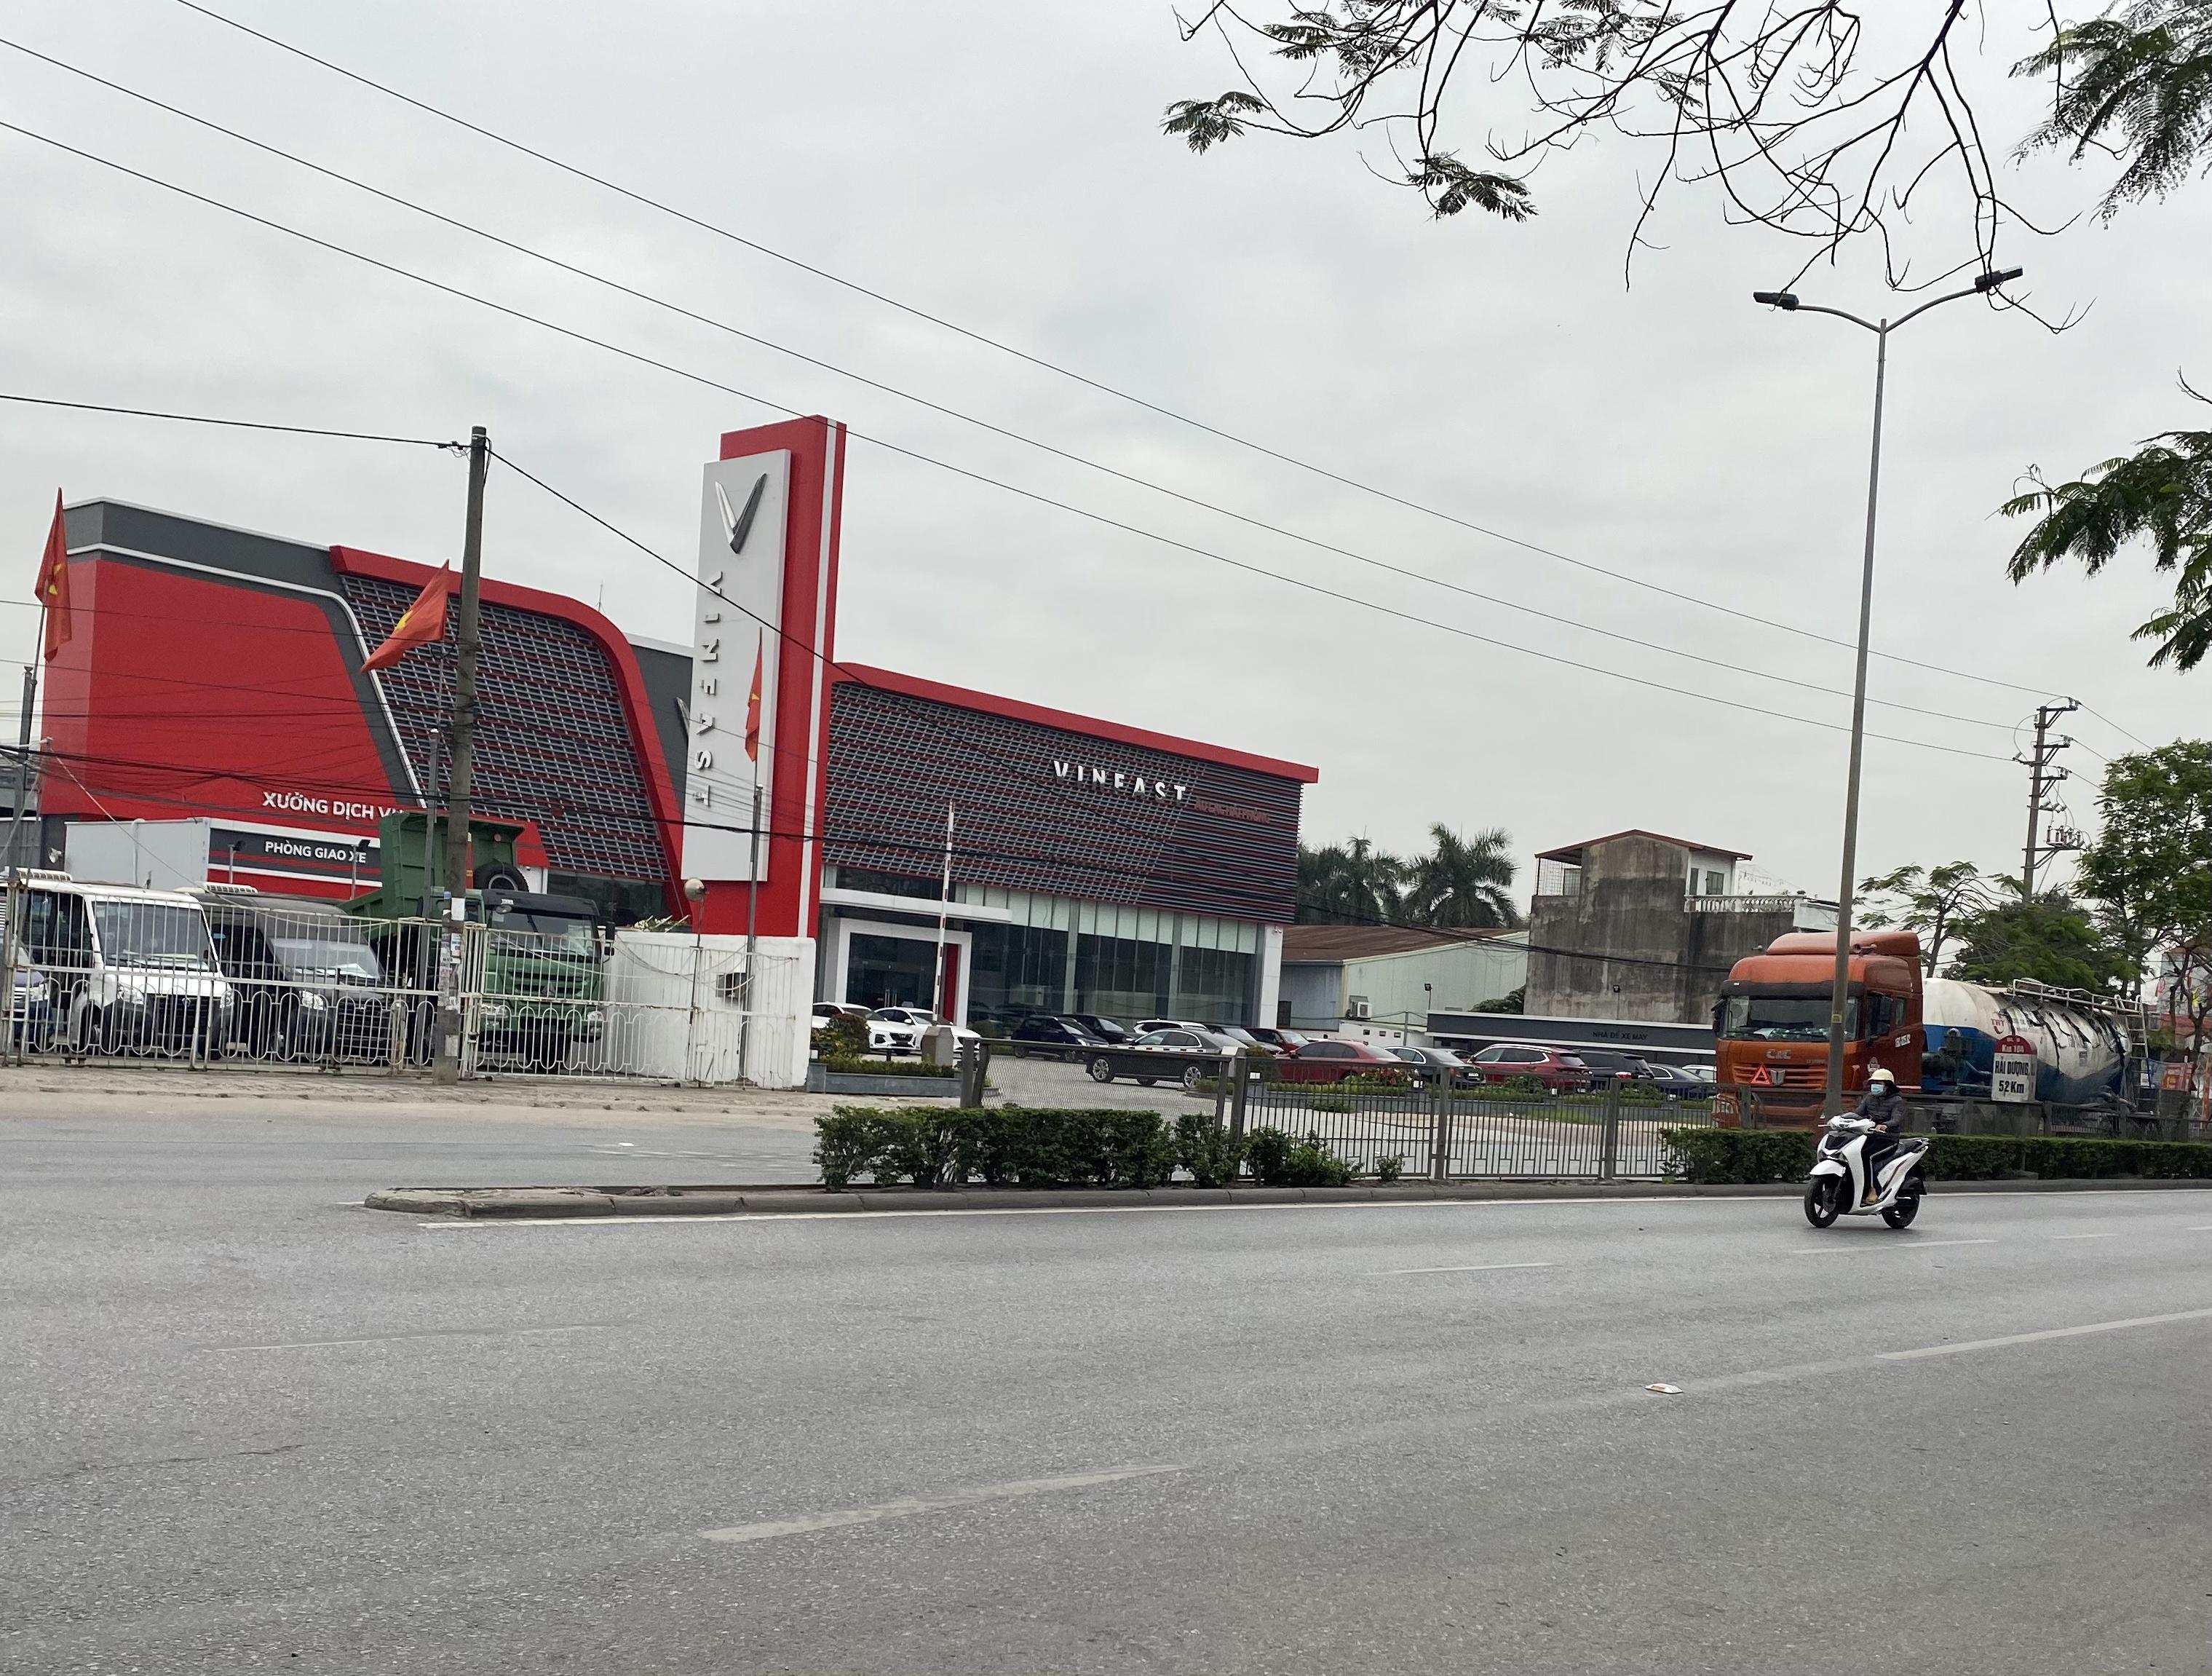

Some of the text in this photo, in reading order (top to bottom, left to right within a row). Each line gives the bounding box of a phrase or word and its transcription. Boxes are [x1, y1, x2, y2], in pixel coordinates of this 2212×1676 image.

[694, 571, 723, 807] VINFAST
[1053, 760, 1186, 801] VINFAST
[262, 791, 404, 821] XƯỞNG DỊCH V
[265, 839, 367, 863] PHÒNG GIAO XE
[1995, 1056, 2006, 1075] HẢI
[1998, 1080, 2025, 1094] 52 Km
